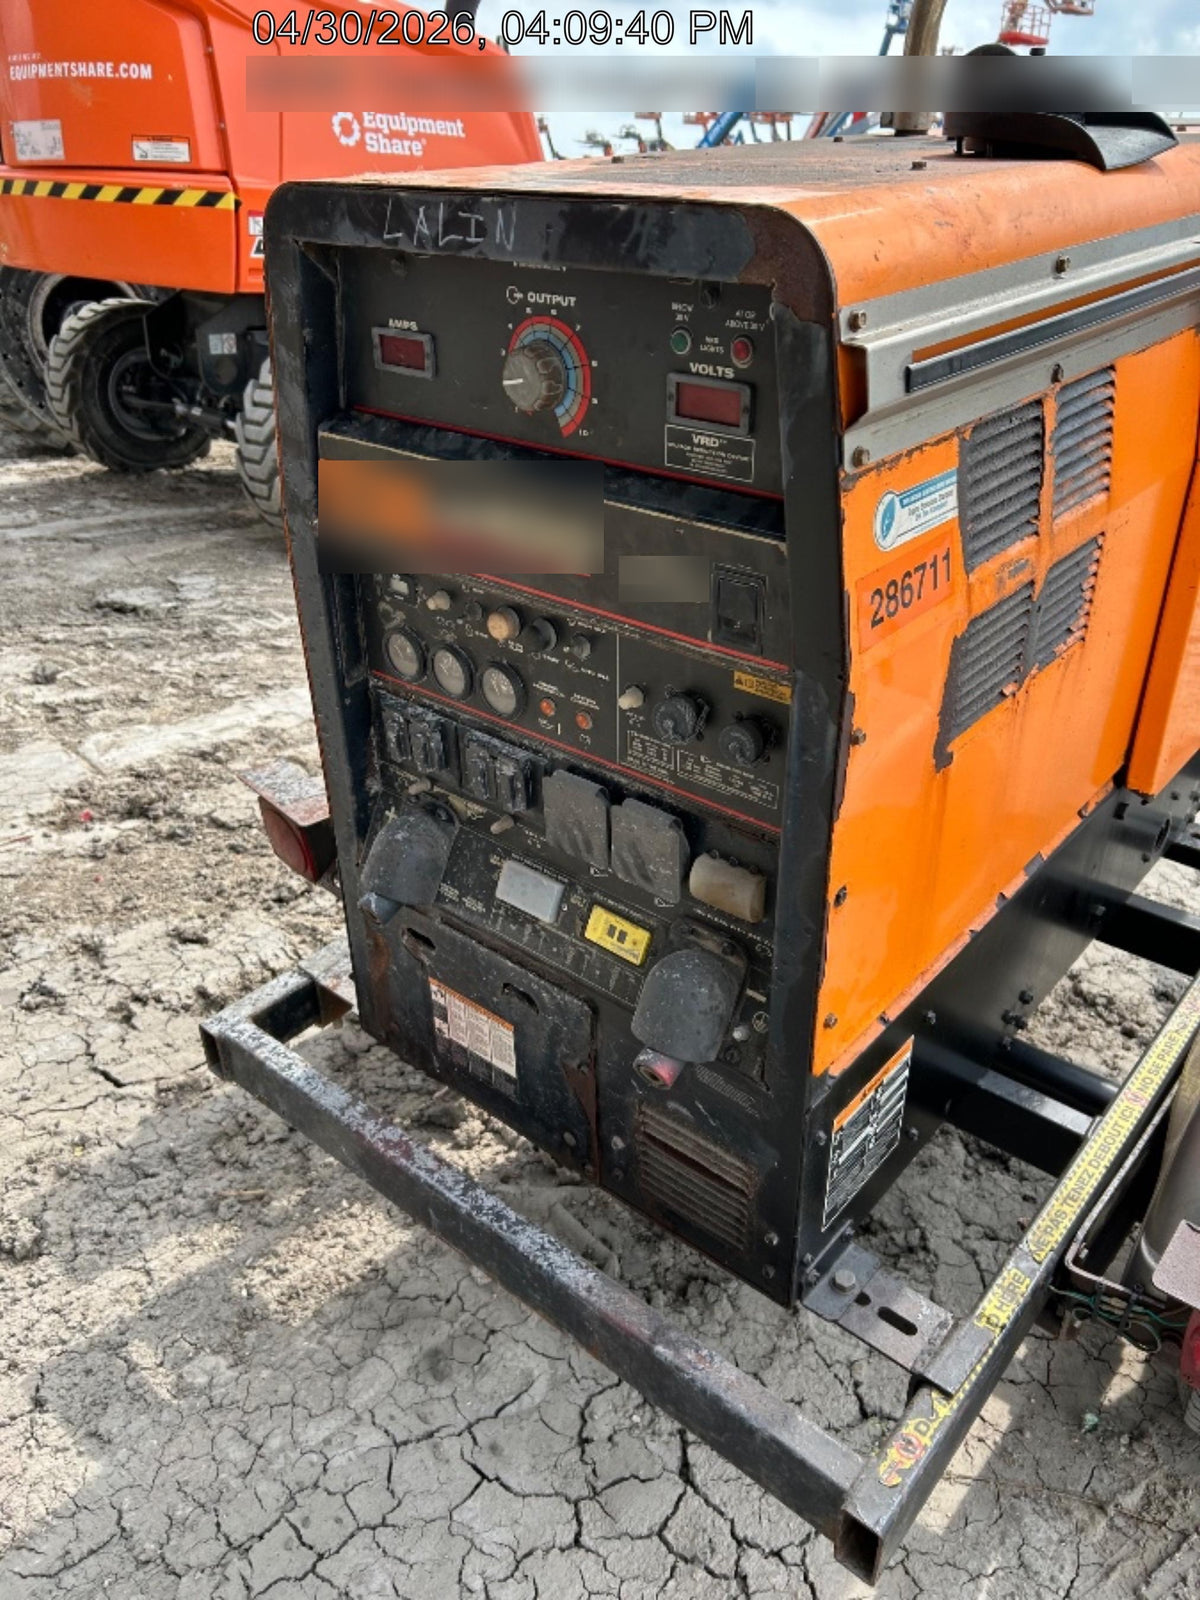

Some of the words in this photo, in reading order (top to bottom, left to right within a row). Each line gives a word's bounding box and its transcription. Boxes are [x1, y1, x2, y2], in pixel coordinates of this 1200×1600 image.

[10, 62, 153, 80] EQUIPMENTSHARE.COM
[363, 112, 466, 138] Equipment
[527, 291, 577, 307] OUTPUT
[388, 318, 419, 332] AMPS
[689, 362, 736, 380] VOLTS
[870, 546, 951, 631] 286711
[1046, 1207, 1068, 1242] PAS
[1061, 1169, 1095, 1212] TENEZ
[1087, 1119, 1129, 1172] DEBOUT
